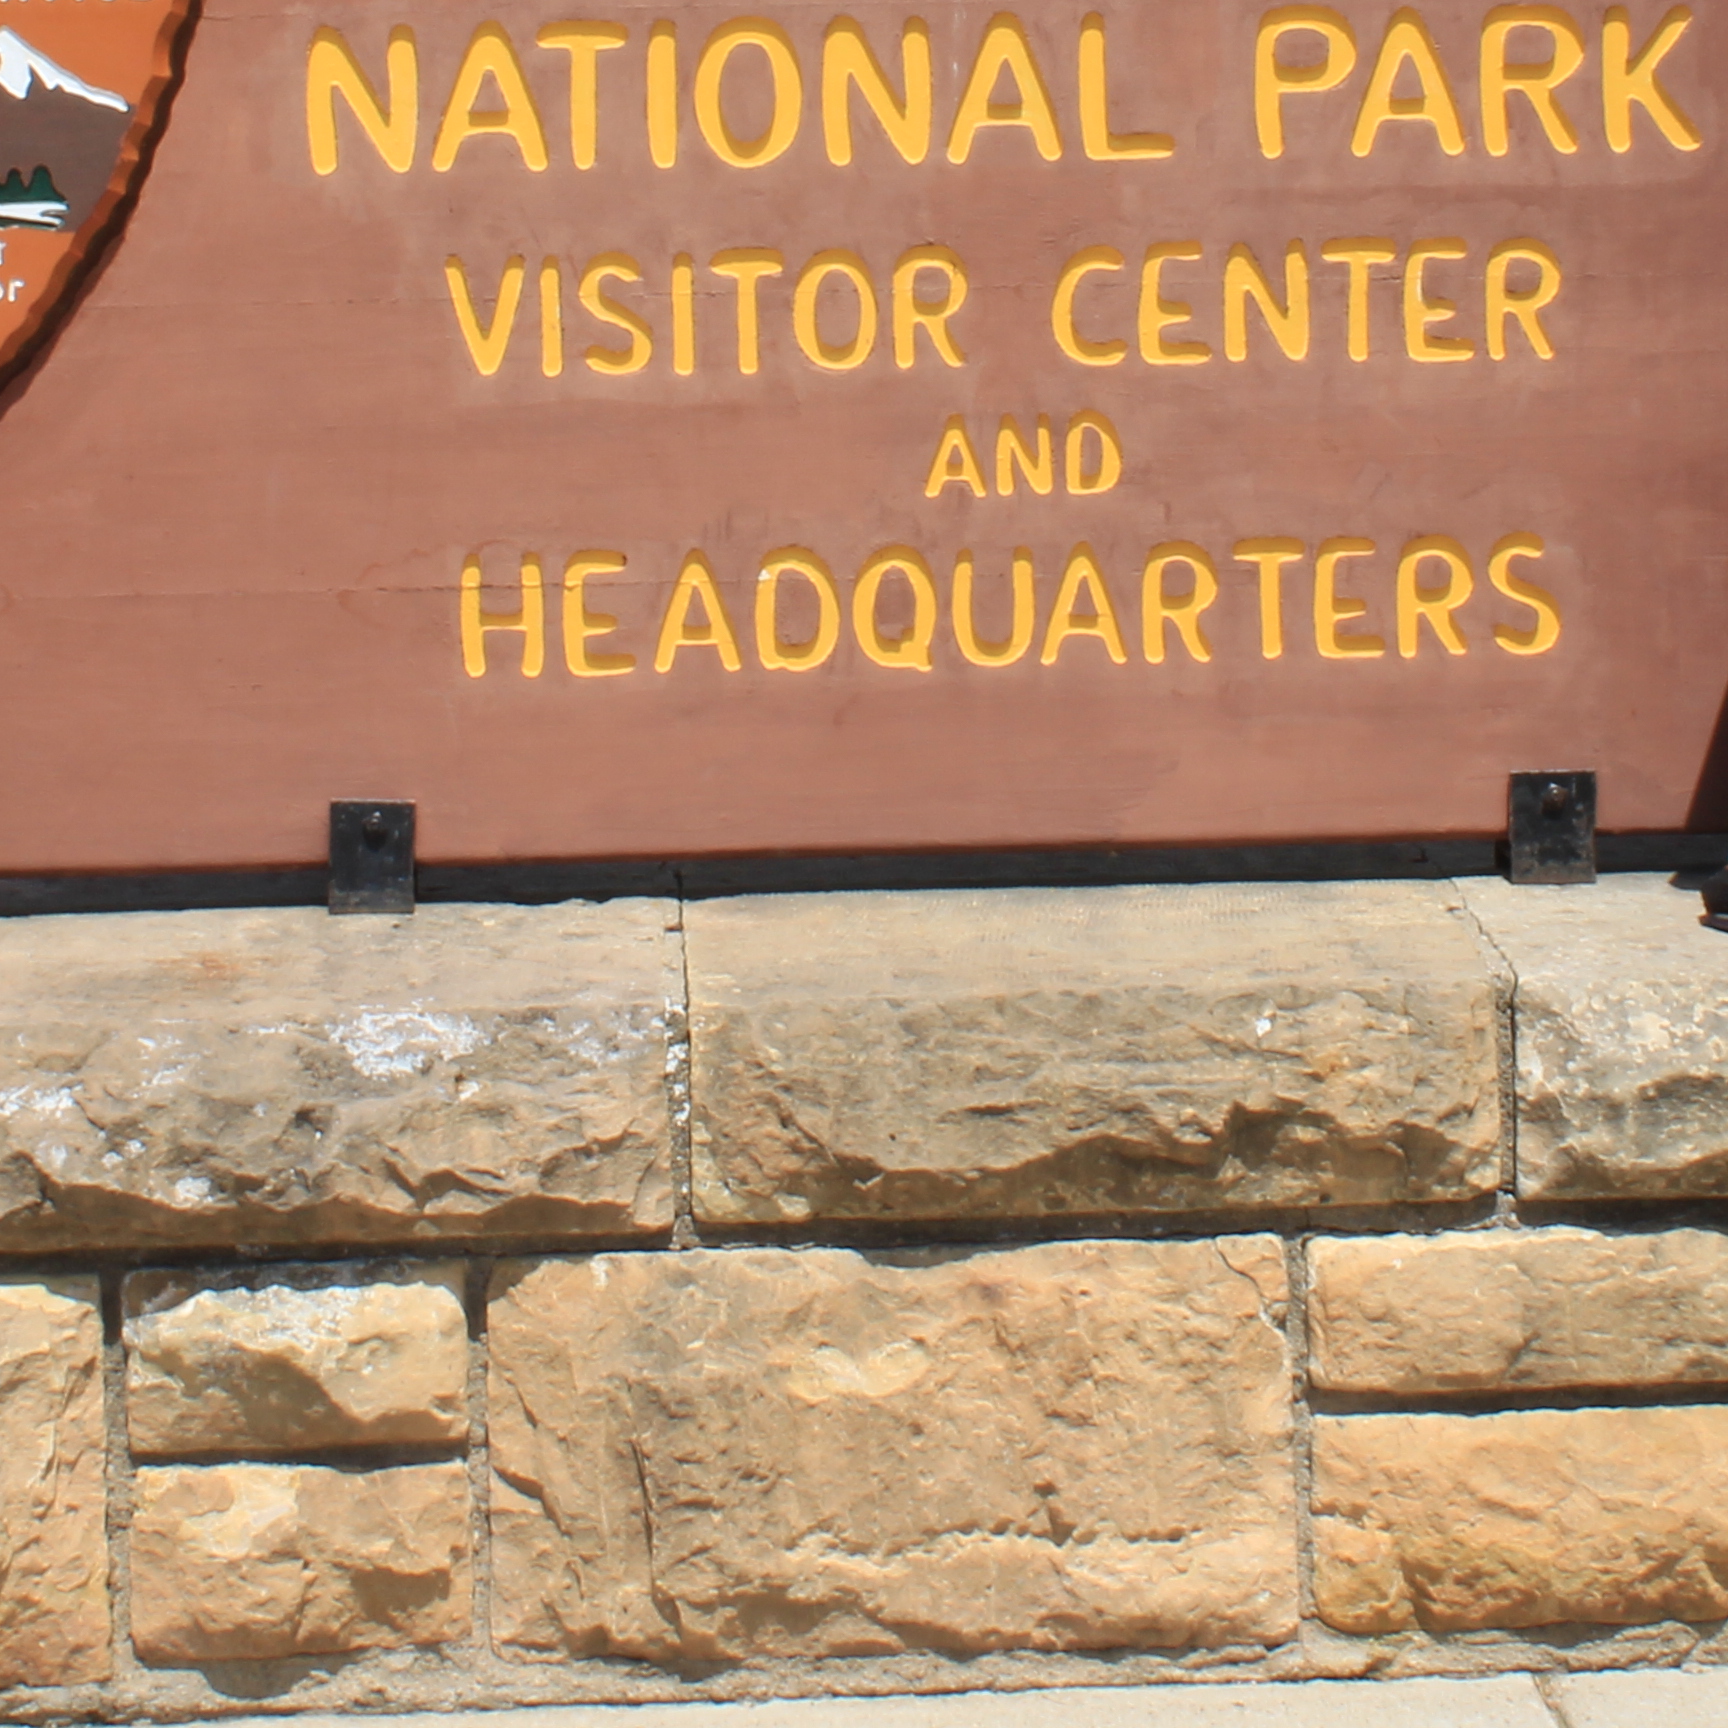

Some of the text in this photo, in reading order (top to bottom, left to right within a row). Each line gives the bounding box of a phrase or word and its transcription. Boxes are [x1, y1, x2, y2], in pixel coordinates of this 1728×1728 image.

[304, 12, 1176, 174] NATIONAL
[443, 234, 1564, 378] VISITOR CENTER
[922, 406, 1125, 499] AND
[458, 528, 1563, 679] HEADQUARTERS
